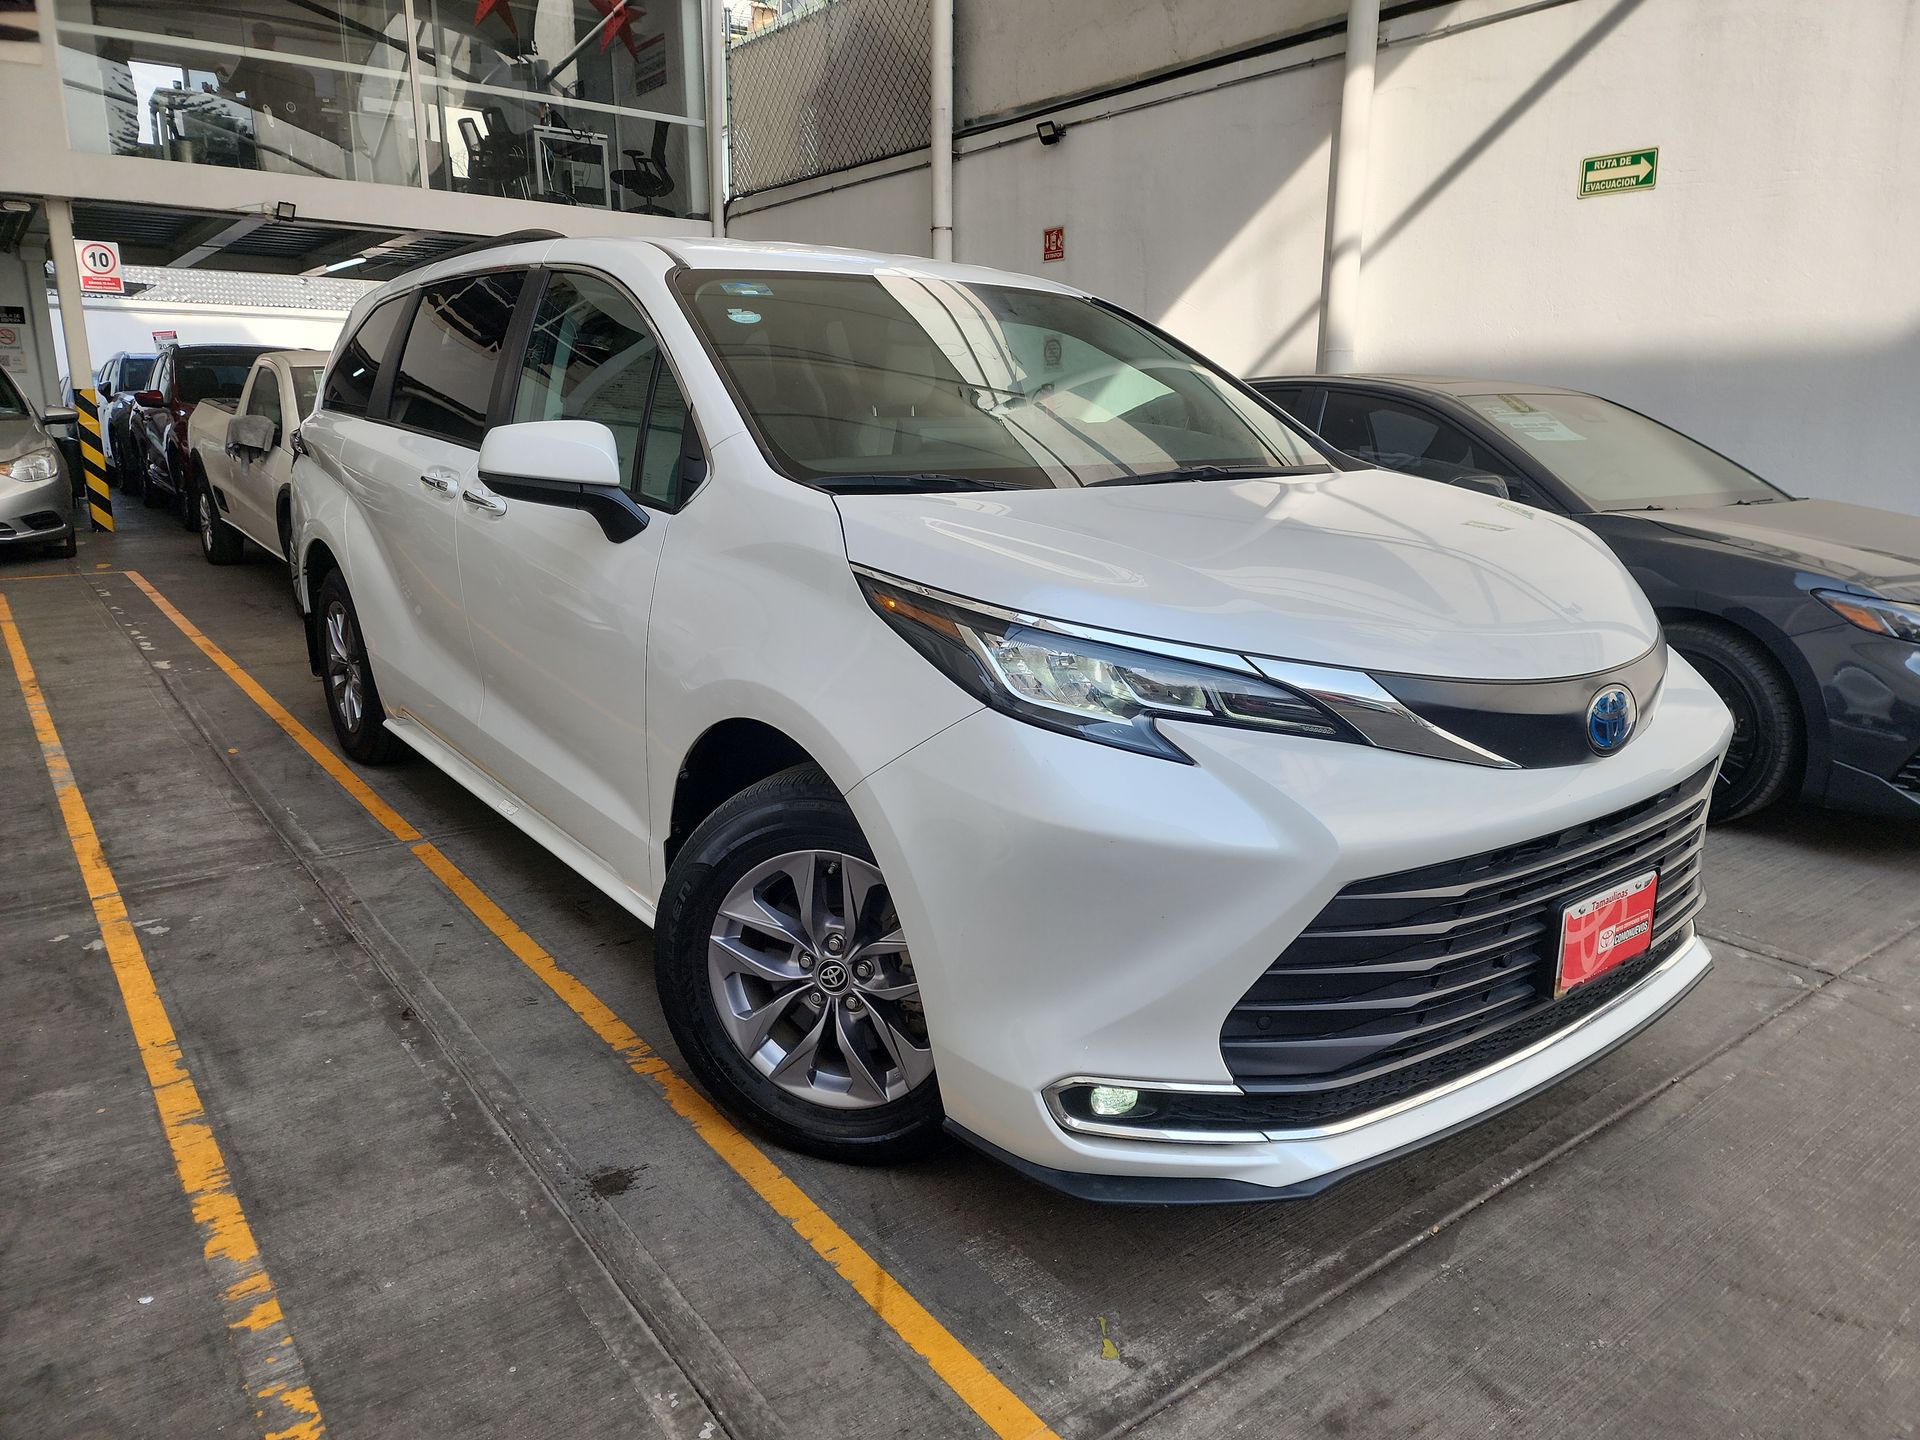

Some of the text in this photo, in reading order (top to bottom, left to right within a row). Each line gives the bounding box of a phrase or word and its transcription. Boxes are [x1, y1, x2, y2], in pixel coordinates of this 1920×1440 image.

[1594, 156, 1632, 170] RUTA DE
[1585, 177, 1637, 191] EVACUACION
[89, 251, 109, 267] 10
